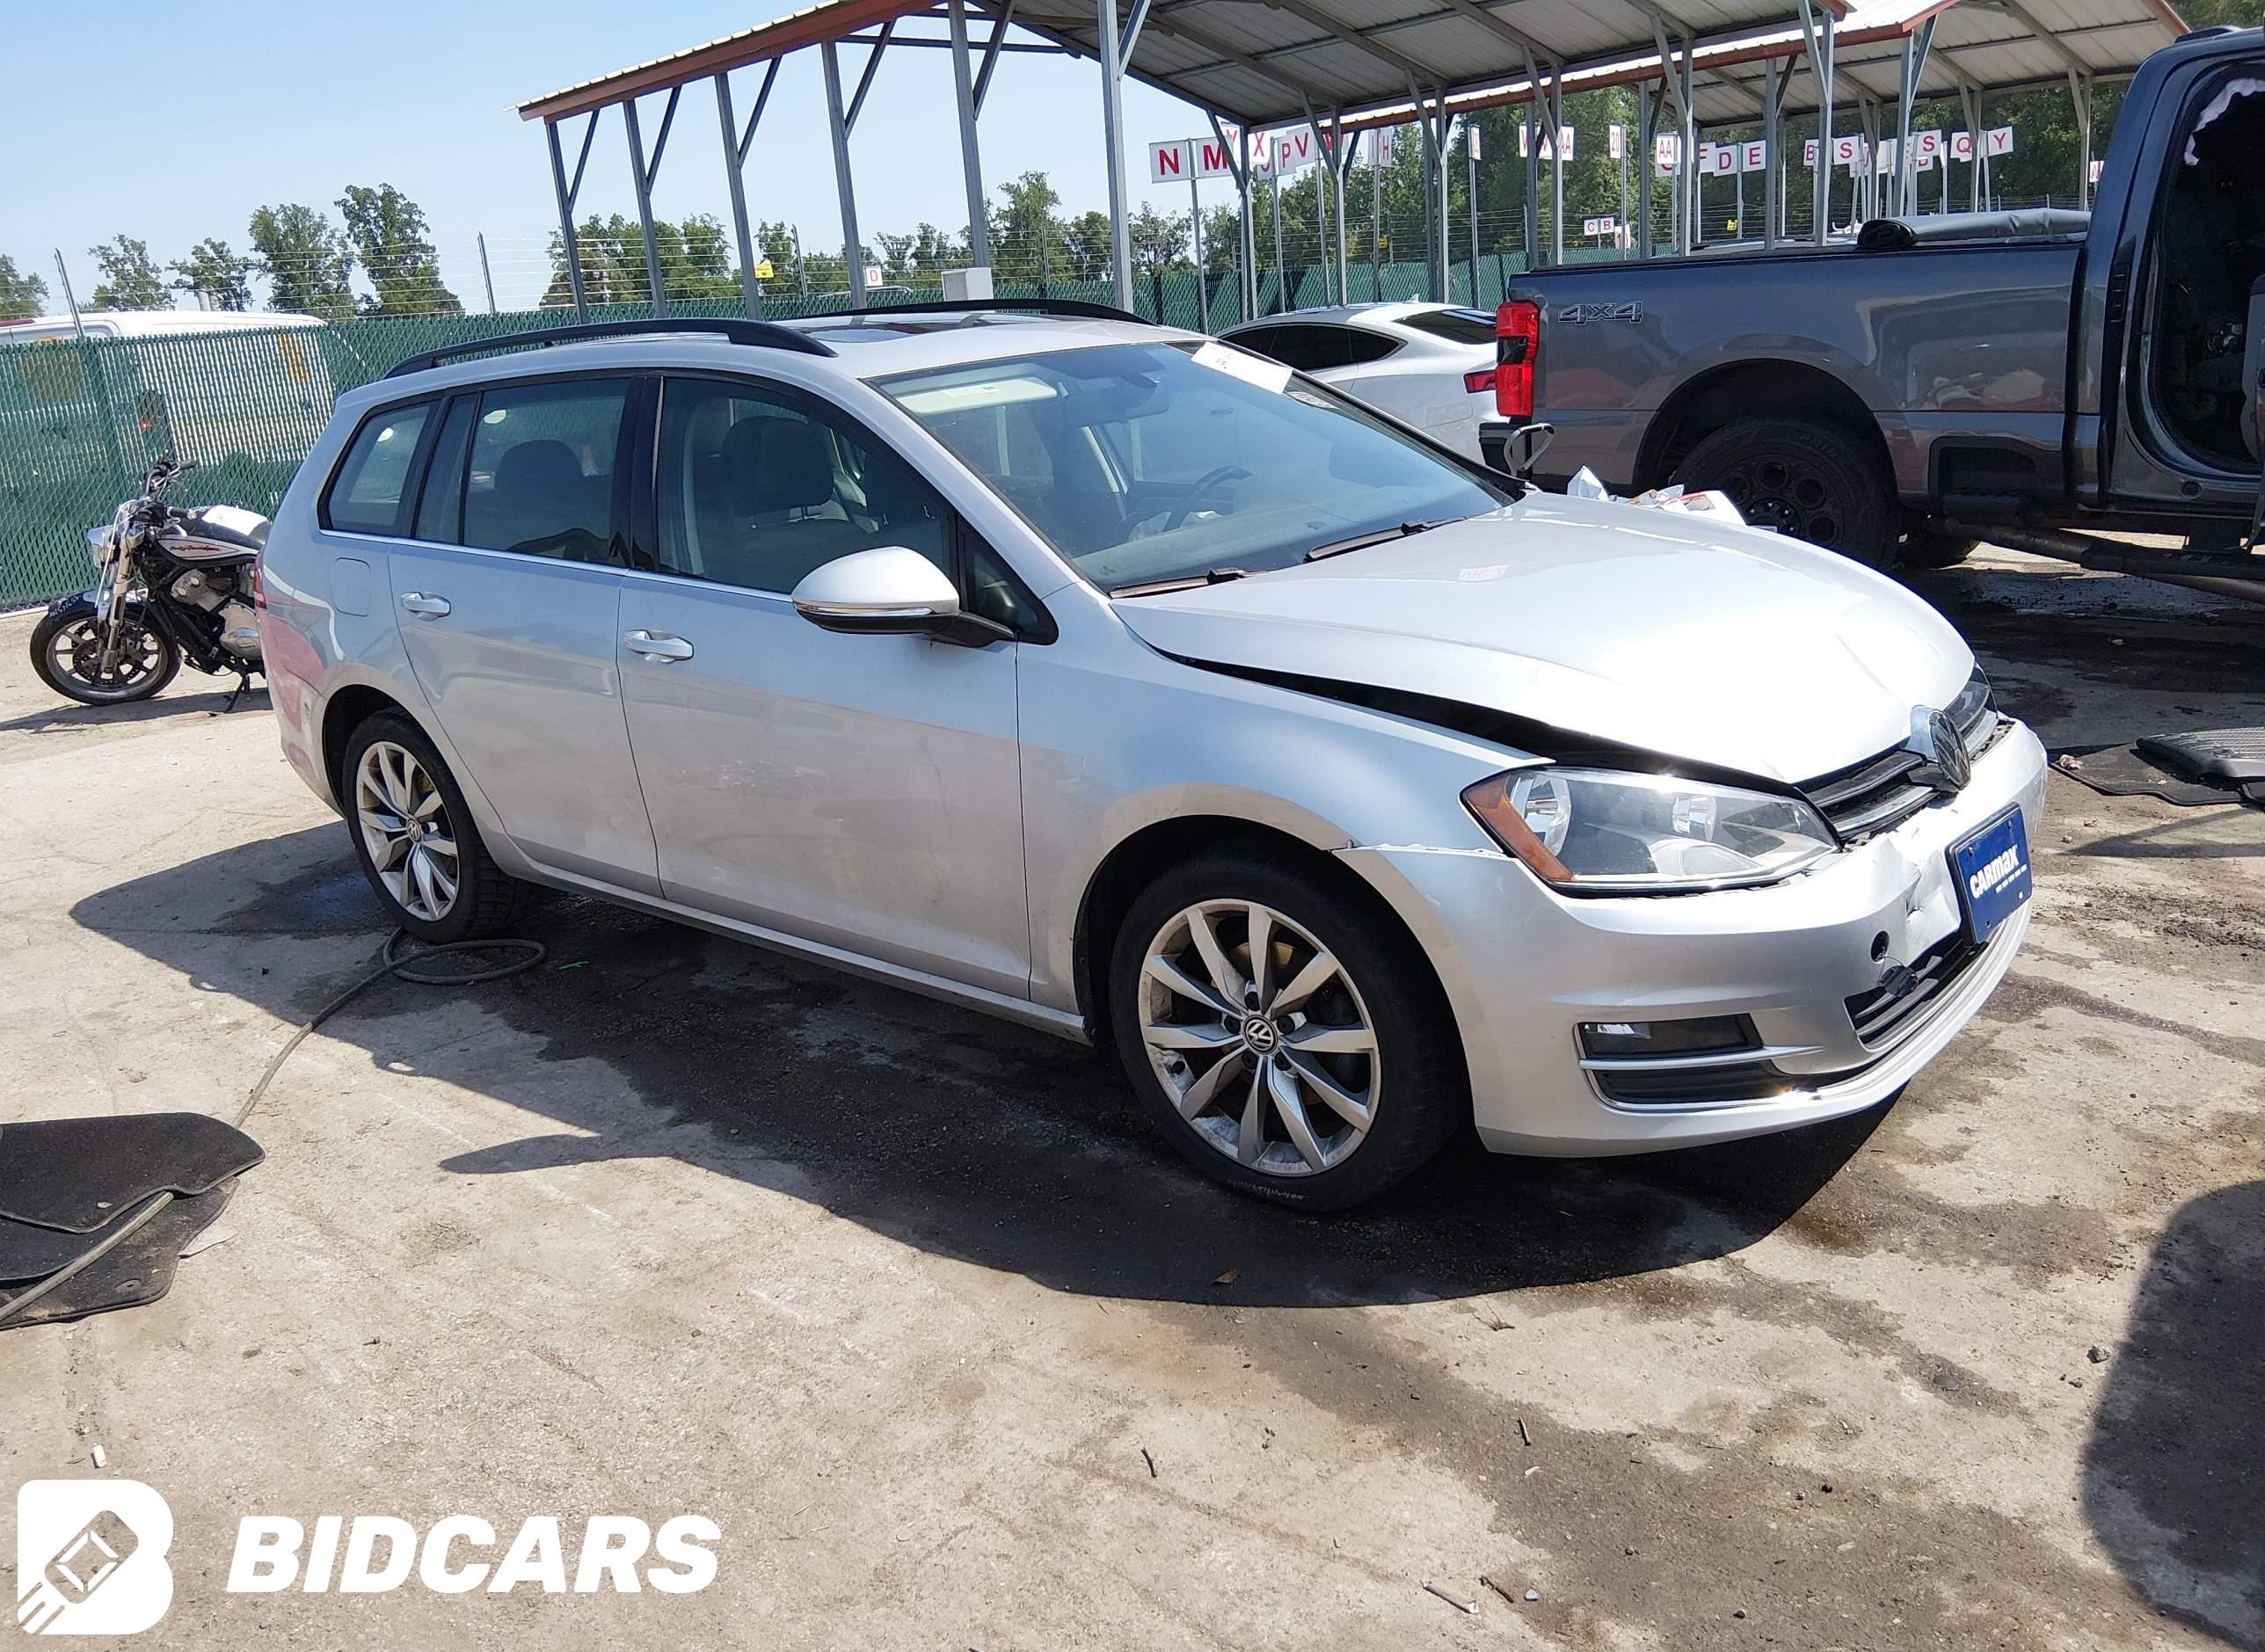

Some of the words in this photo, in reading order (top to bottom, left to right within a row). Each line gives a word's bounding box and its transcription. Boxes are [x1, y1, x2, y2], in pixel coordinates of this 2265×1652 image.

[1253, 133, 1265, 156] X
[1294, 132, 1309, 157] V
[1382, 135, 1389, 160] H
[1658, 139, 1672, 158] AA
[1922, 135, 1935, 152] S
[1956, 136, 1972, 154] Q
[1993, 132, 2006, 149] Y
[1202, 144, 1228, 171] M
[1749, 146, 1761, 165] E
[1839, 142, 1853, 159] S
[1159, 148, 1180, 176] N
[1718, 151, 1732, 171] D
[1587, 222, 1595, 232] C
[1603, 220, 1611, 230] B
[870, 269, 878, 282] D
